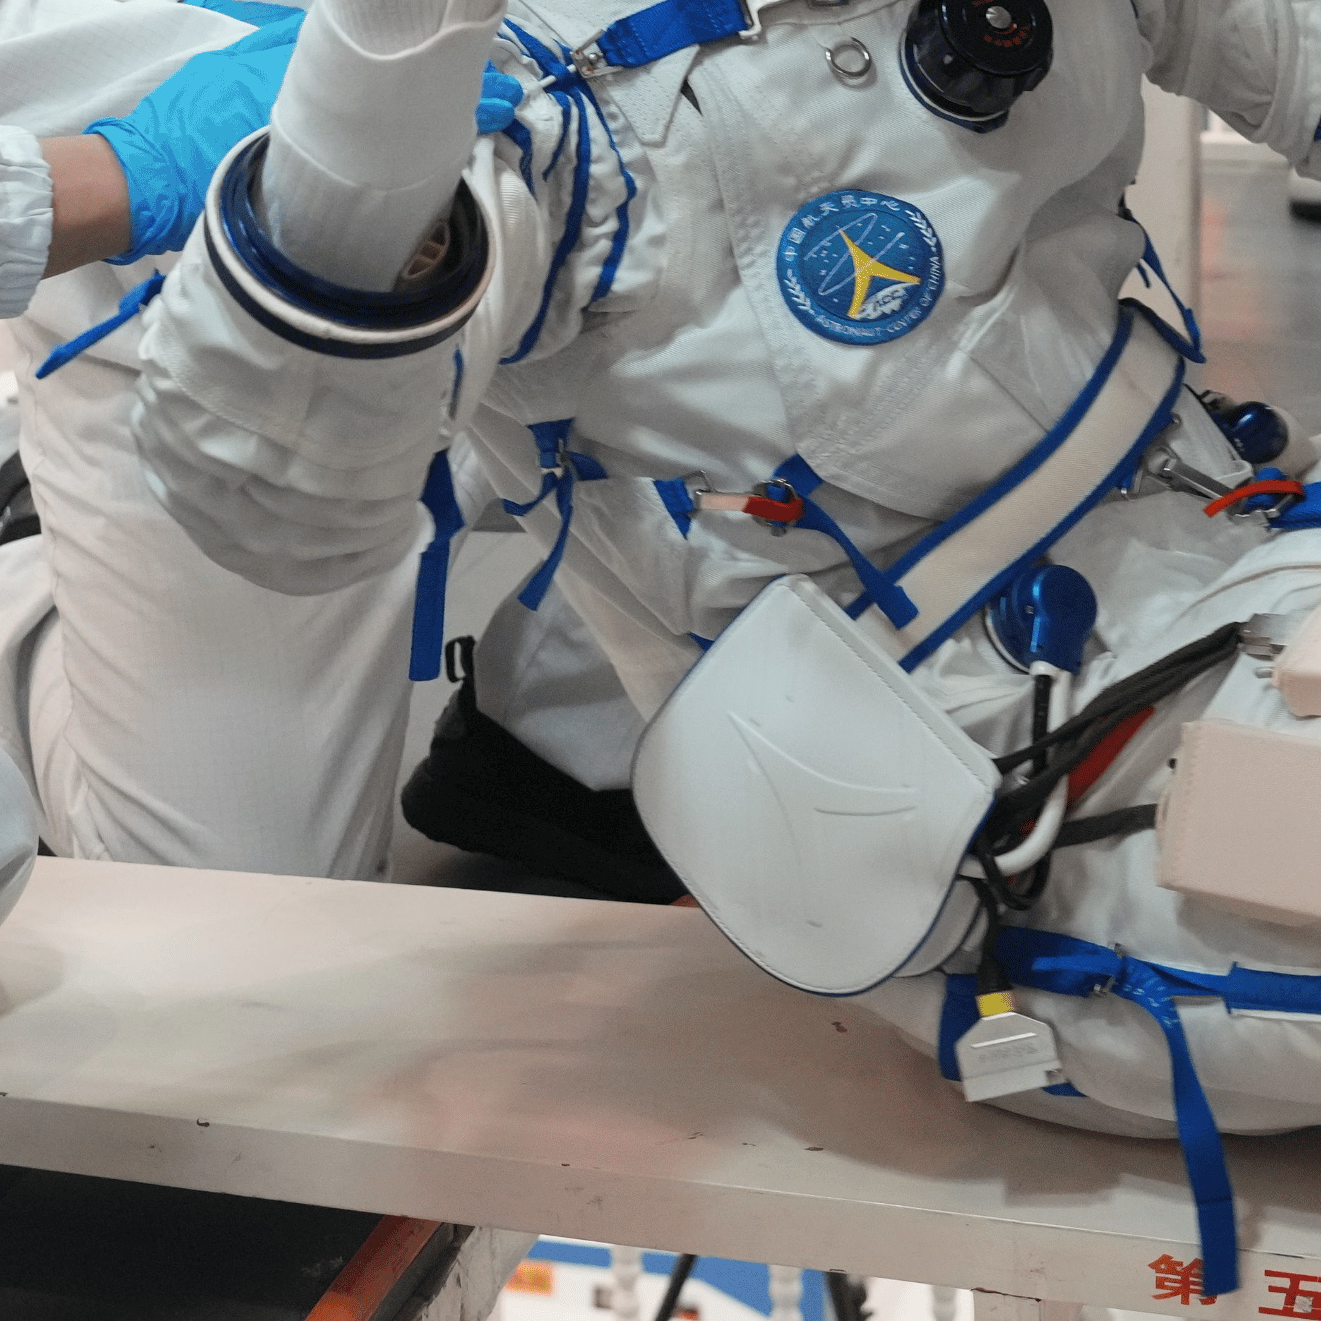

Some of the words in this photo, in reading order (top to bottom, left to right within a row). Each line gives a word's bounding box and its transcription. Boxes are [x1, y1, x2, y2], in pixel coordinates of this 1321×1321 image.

[782, 194, 900, 262] 中国航天员中心
[919, 292, 933, 307] OF
[927, 256, 942, 290] CHINA
